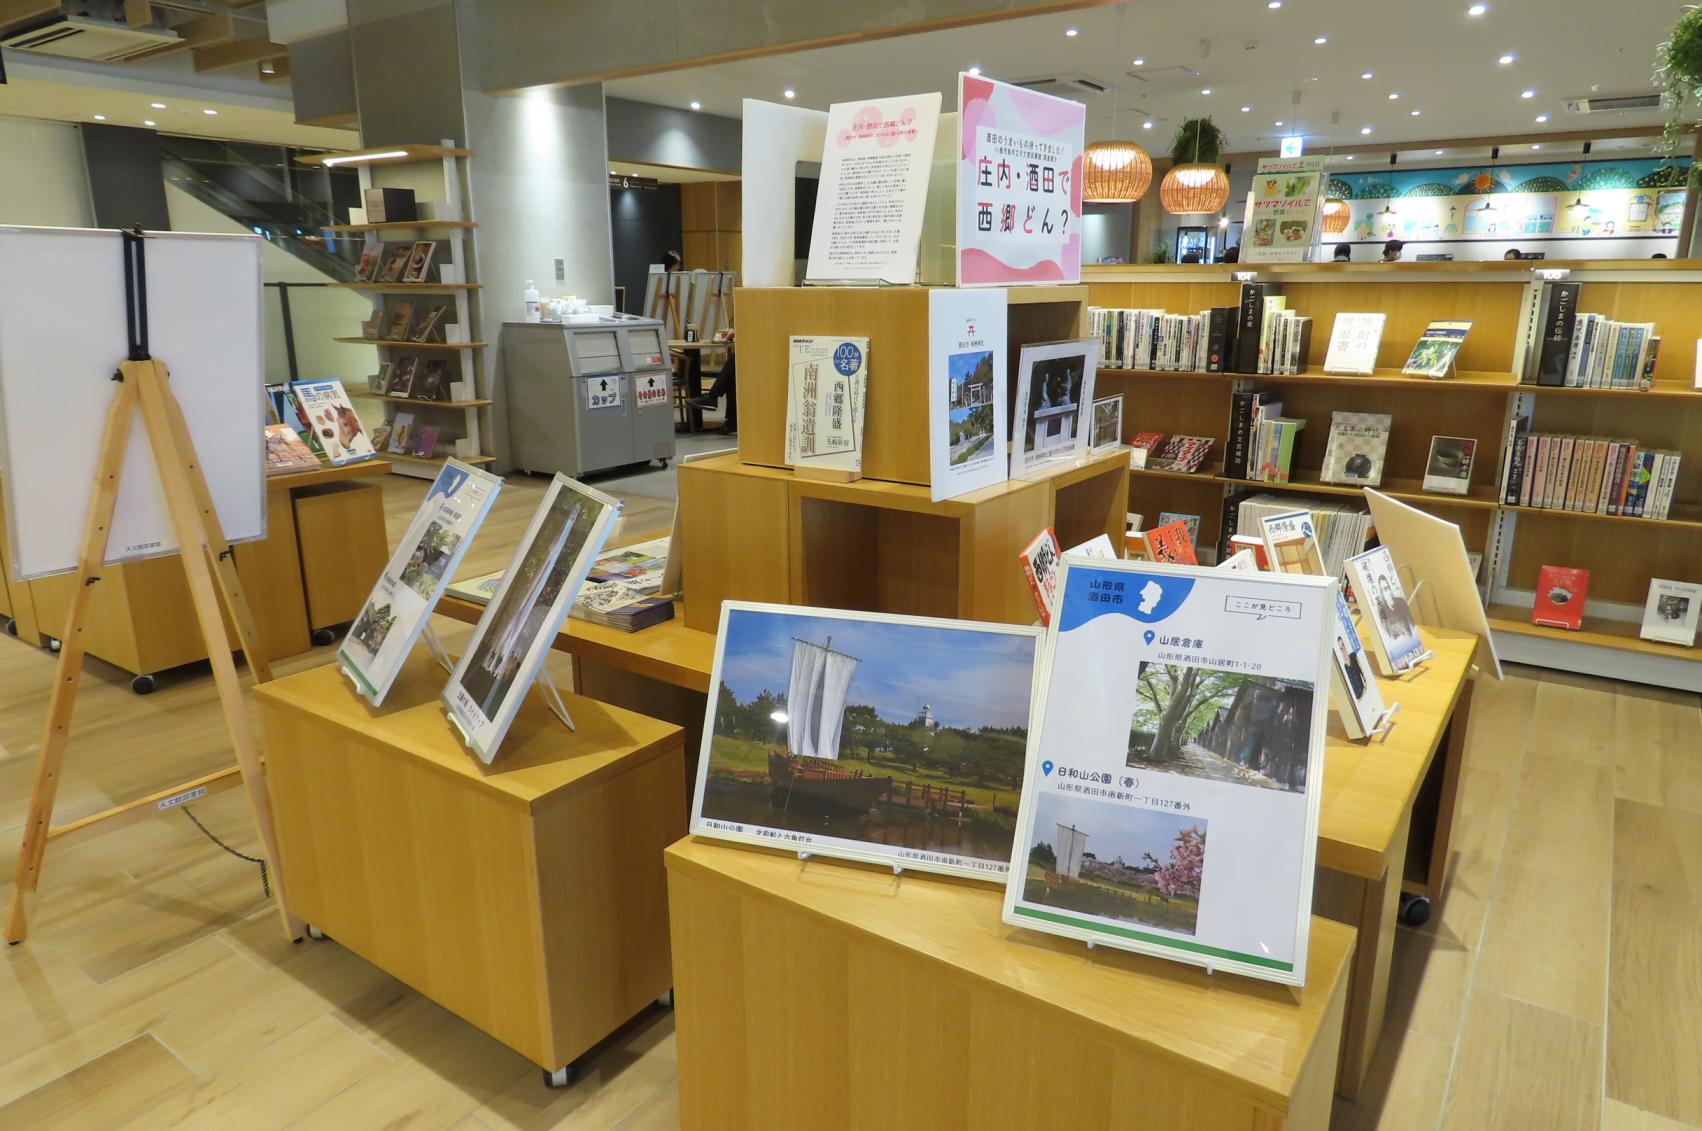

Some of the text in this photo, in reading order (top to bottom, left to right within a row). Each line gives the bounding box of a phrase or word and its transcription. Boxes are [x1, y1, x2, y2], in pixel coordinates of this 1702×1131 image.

[977, 155, 1070, 195] 庄内・酒田で
[977, 202, 1069, 235] 西郷どん？
[591, 391, 617, 406] カップ
[832, 380, 845, 430] 西郷隆盛
[801, 362, 819, 454] 南洲翁遺訓
[1089, 579, 1126, 593] 山形県
[1087, 592, 1125, 605] 酒田市
[1235, 600, 1292, 614] ここが見どころ
[1159, 635, 1204, 650] 山居倉庫
[1157, 651, 1262, 671] 山形県酒田市山居町1-1-20
